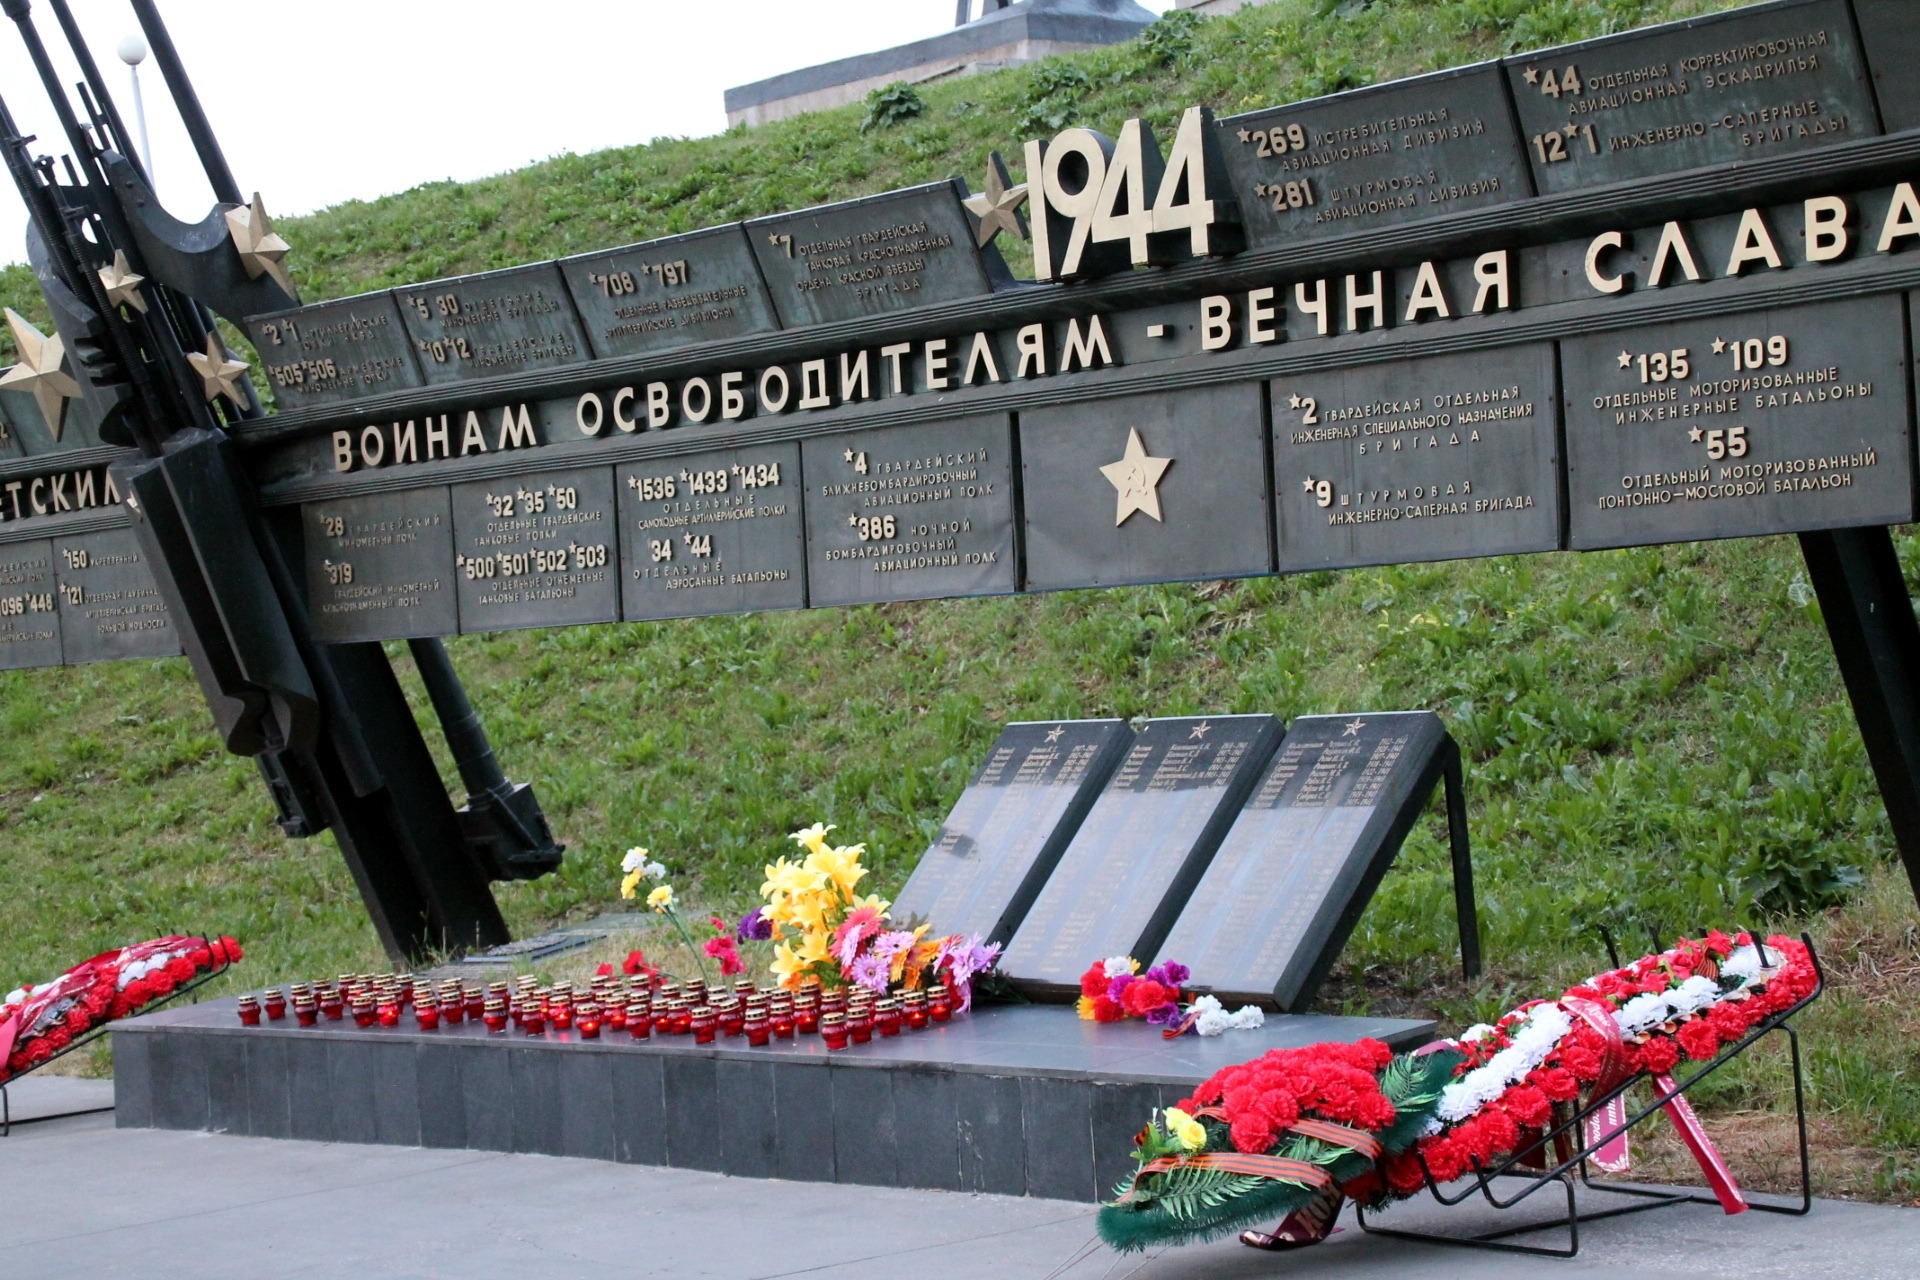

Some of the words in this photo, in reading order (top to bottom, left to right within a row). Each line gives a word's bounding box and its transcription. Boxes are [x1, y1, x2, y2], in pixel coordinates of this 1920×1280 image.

[1541, 66, 1581, 98] 44
[1589, 64, 1668, 90] ОТДЕЛЬНАЯ
[1680, 31, 1827, 72] КОРРЕКТИРОВОЧНАЯ
[1569, 81, 1688, 115] АВИАЦИОННАЯ
[1706, 55, 1818, 88] ЭСКАДРИЛЬЯ
[1253, 123, 1305, 158] 269
[1315, 109, 1448, 146] ИСТРЕБИТЕЛЬНАЯ
[1533, 132, 1567, 163] 12
[1584, 123, 1598, 154] 1
[1743, 117, 1846, 147] БРИГАДЫ
[1282, 140, 1390, 171] АВИАЦИОННАЯ
[1404, 121, 1484, 149] ДИВИЗИЯ
[1024, 106, 1214, 281] 1944
[1268, 178, 1314, 212] 281
[1330, 171, 1437, 200] ШТУРМОВАЯ
[1316, 194, 1415, 223] АВИАЦИОННАЯ
[1429, 178, 1500, 203] ДИВИЗИЯ
[780, 235, 793, 258] 7
[800, 237, 853, 255] ОТДЕЛЬНАЯ
[857, 222, 927, 245] ГВАРДЕЙСКАЯ
[806, 254, 852, 271] ТАНКОВАЯ
[858, 235, 951, 263] КРАСНОЗНАМЕННАЯ
[598, 272, 634, 296] 708
[653, 260, 689, 286] 797
[798, 277, 832, 291] ОРДЕНА
[838, 265, 882, 284] КРАСНОЙ
[888, 259, 924, 275] ЗВЕЗДЫ
[857, 279, 920, 298] БРИГАДА
[416, 298, 429, 318] 5
[437, 294, 459, 315] 30
[615, 302, 658, 319] ОТДЕЛЬНЫЕ
[268, 325, 281, 345] 2
[332, 403, 537, 472] ВОИНАМ
[576, 314, 1112, 436] ОСВОБОДИТЕЛЯМ
[1201, 250, 1510, 350] ВЕЧНАЯ
[1587, 182, 1920, 294] СЛАВА
[604, 318, 675, 338] АРТИЛЛЕРИЙСКИЕ
[681, 309, 732, 325] ДИВИЗИОНЫ
[428, 342, 445, 362] 10
[452, 338, 470, 358] 12
[1637, 349, 1689, 383] 135
[1730, 335, 1787, 371] 109
[277, 365, 304, 387] 505
[307, 359, 336, 380] 506
[1594, 388, 1676, 408] ОТДЕЛЬНЫЕ
[1690, 367, 1838, 396] МОТОРИЗОВАННЫЕ
[1301, 398, 1317, 425] 2
[1325, 398, 1421, 422] ГВАРДЕЙСКАЯ
[1434, 386, 1519, 408] ОТДЕЛЬНАЯ
[1616, 398, 1738, 425] ИНЖЕНЕРНЫЕ
[1756, 383, 1872, 408] БАТАЛЬОНЫ
[1291, 425, 1358, 444] ИНЖЕНЕРНАЯ
[1364, 414, 1450, 436] СПЕЦИАЛЬНОГО
[1459, 404, 1532, 424] НАЗНАЧЕНИЯ
[1360, 431, 1479, 454] БРИГАДА
[1707, 427, 1747, 460] 55
[855, 452, 867, 474] 4
[878, 448, 988, 473] ГВАРДЕЙСКИЙ
[1622, 465, 1710, 488] ОТДЕЛЬНЫЙ
[1720, 447, 1876, 479] МОТОРИЗОВАННЫЙ
[637, 476, 675, 500] 1536
[689, 470, 727, 495] 1433
[740, 463, 779, 488] 1434
[823, 467, 977, 496] БЛИЖНЕБОМБАРДИРОВОЧНЫЙ
[1316, 480, 1332, 507] 9
[1341, 481, 1471, 506] ШТУРМОВАЯ
[1774, 474, 1850, 493] БАТАЛЬОН
[494, 495, 513, 516] 32
[525, 491, 544, 513] 35
[557, 488, 576, 509] 50
[664, 494, 754, 513] ОТДЕЛЬНЫЕ
[864, 486, 951, 507] АВИАЦИОННЫЙ
[961, 484, 993, 497] ПОЛК
[1476, 496, 1533, 512] БРИГАДА
[326, 517, 343, 536] 28
[488, 518, 537, 532] ОТДЕЛЬНЫЕ
[543, 511, 601, 526] ГВАРДЕЙСКИЕ
[639, 516, 688, 529] САМОХОДНЫЕ
[692, 507, 755, 524] АРТИЛЛЕРИЙСКИЕ
[759, 505, 786, 516] ПОЛКИ
[859, 515, 895, 540] 386
[911, 519, 970, 535] НОЧНОЙ
[475, 534, 519, 546] ТАНКОВЫЕ
[527, 530, 557, 541] ПОЛКИ
[651, 539, 671, 562] 34
[691, 535, 710, 557] 44
[826, 537, 956, 560] БОМБАРДИРОВОЧНЫЙ
[68, 550, 87, 569] 150
[467, 557, 494, 579] 500
[503, 553, 529, 576] 501
[536, 550, 566, 572] 502
[576, 544, 605, 568] 503
[634, 562, 721, 578] ОТДЕЛЬНЫЕ
[874, 553, 958, 571] АВИАЦИОННЫЙ
[966, 551, 996, 563] ПОЛК
[331, 563, 352, 584] 319
[493, 577, 540, 590] ОТДЕЛЬНЫЕ
[666, 575, 725, 590] АЭРОСАННЫЕ
[732, 570, 788, 584] БАТАЛЬОНЫ
[30, 594, 52, 611] 448
[67, 586, 82, 604] 121
[479, 593, 519, 604] ТАНКОВЫЕ
[526, 587, 575, 601] БАТАЛЬОНЫ
